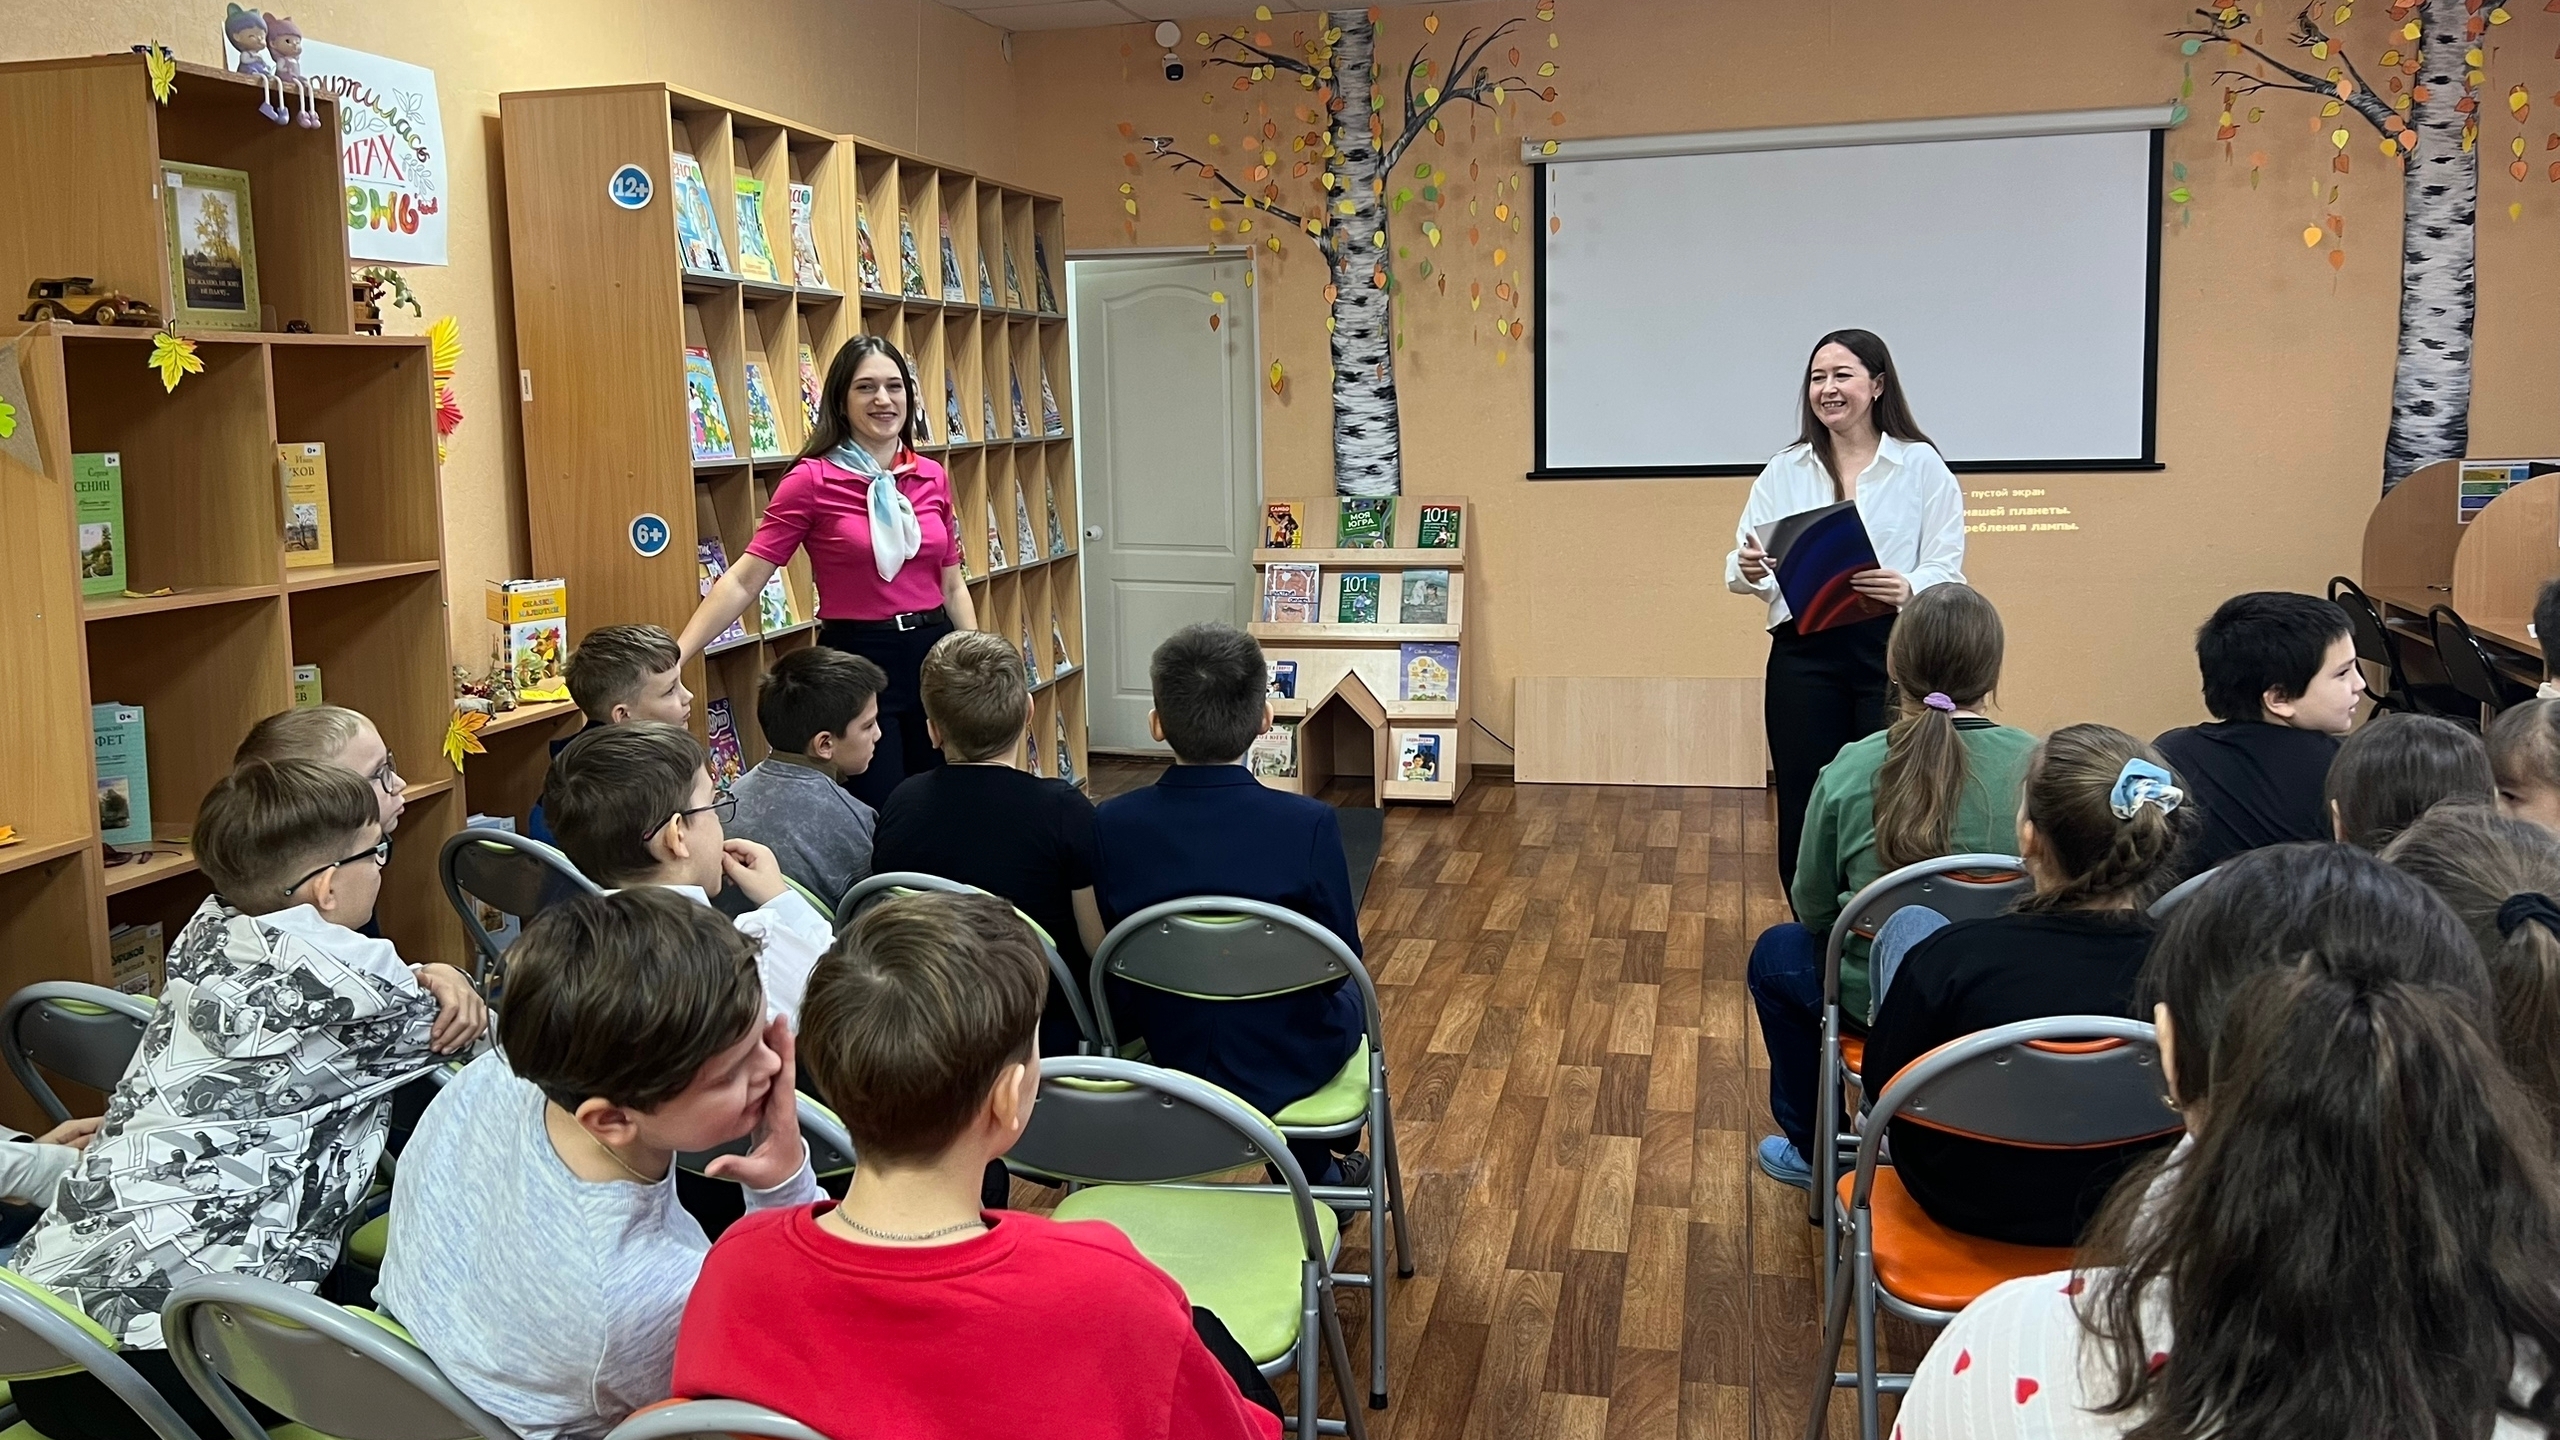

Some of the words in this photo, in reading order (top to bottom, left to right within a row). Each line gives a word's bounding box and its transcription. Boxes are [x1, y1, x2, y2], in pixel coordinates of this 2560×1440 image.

[615, 177, 648, 197] 12+
[1971, 488, 2008, 499] пустой
[2012, 489, 2045, 498] экран
[1350, 511, 1371, 520] МОЯ
[1424, 507, 1449, 523] 101
[1963, 507, 2005, 516] нашей
[2009, 507, 2071, 516] планеты.
[1348, 518, 1374, 528] ЮГРА
[2031, 523, 2079, 532] лампы.
[637, 524, 662, 544] 6+
[1343, 576, 1368, 592] 101
[95, 734, 125, 747] ФЕТ
